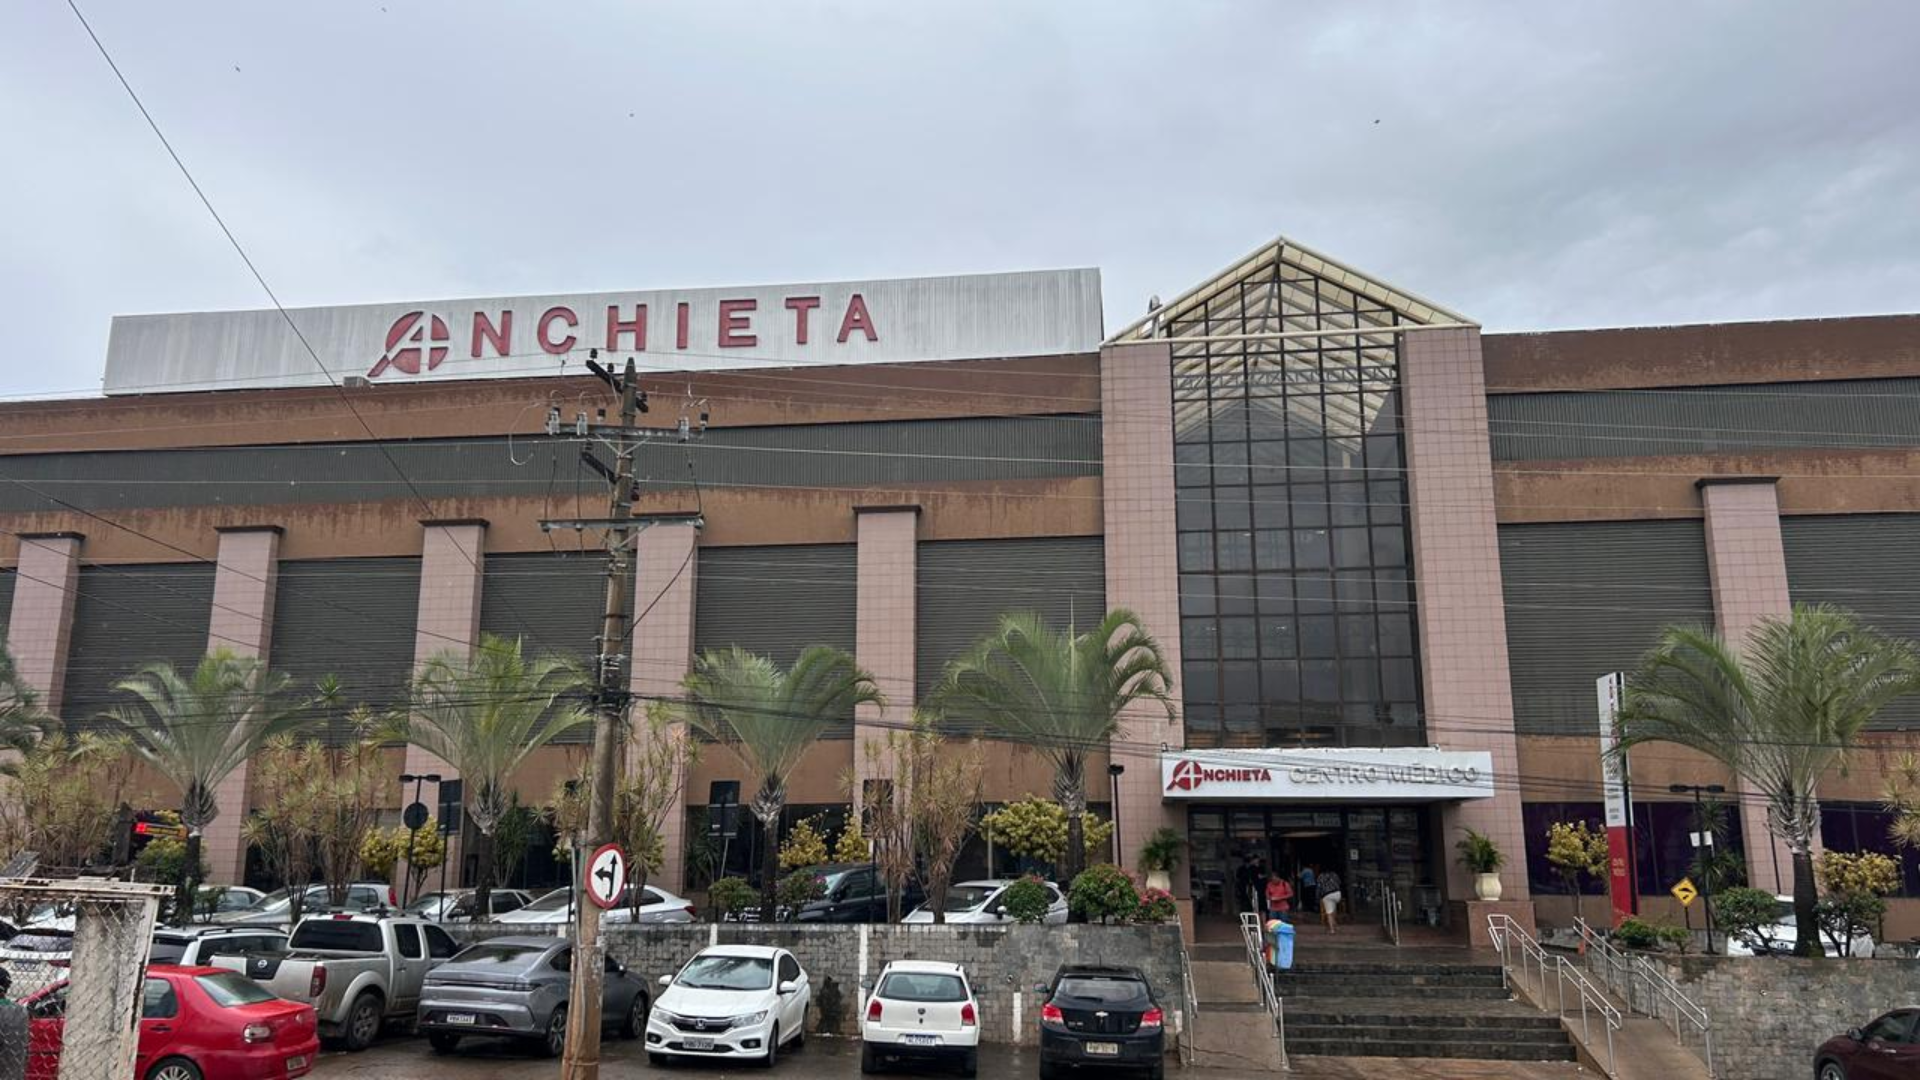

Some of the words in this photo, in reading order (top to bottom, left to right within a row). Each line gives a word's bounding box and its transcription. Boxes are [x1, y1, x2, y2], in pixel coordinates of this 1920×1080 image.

[368, 294, 878, 377] ANCHIETA
[1166, 760, 1271, 791] ANCHIETA
[1289, 766, 1378, 784] CENTRO
[1388, 761, 1478, 784] MÉDICO
